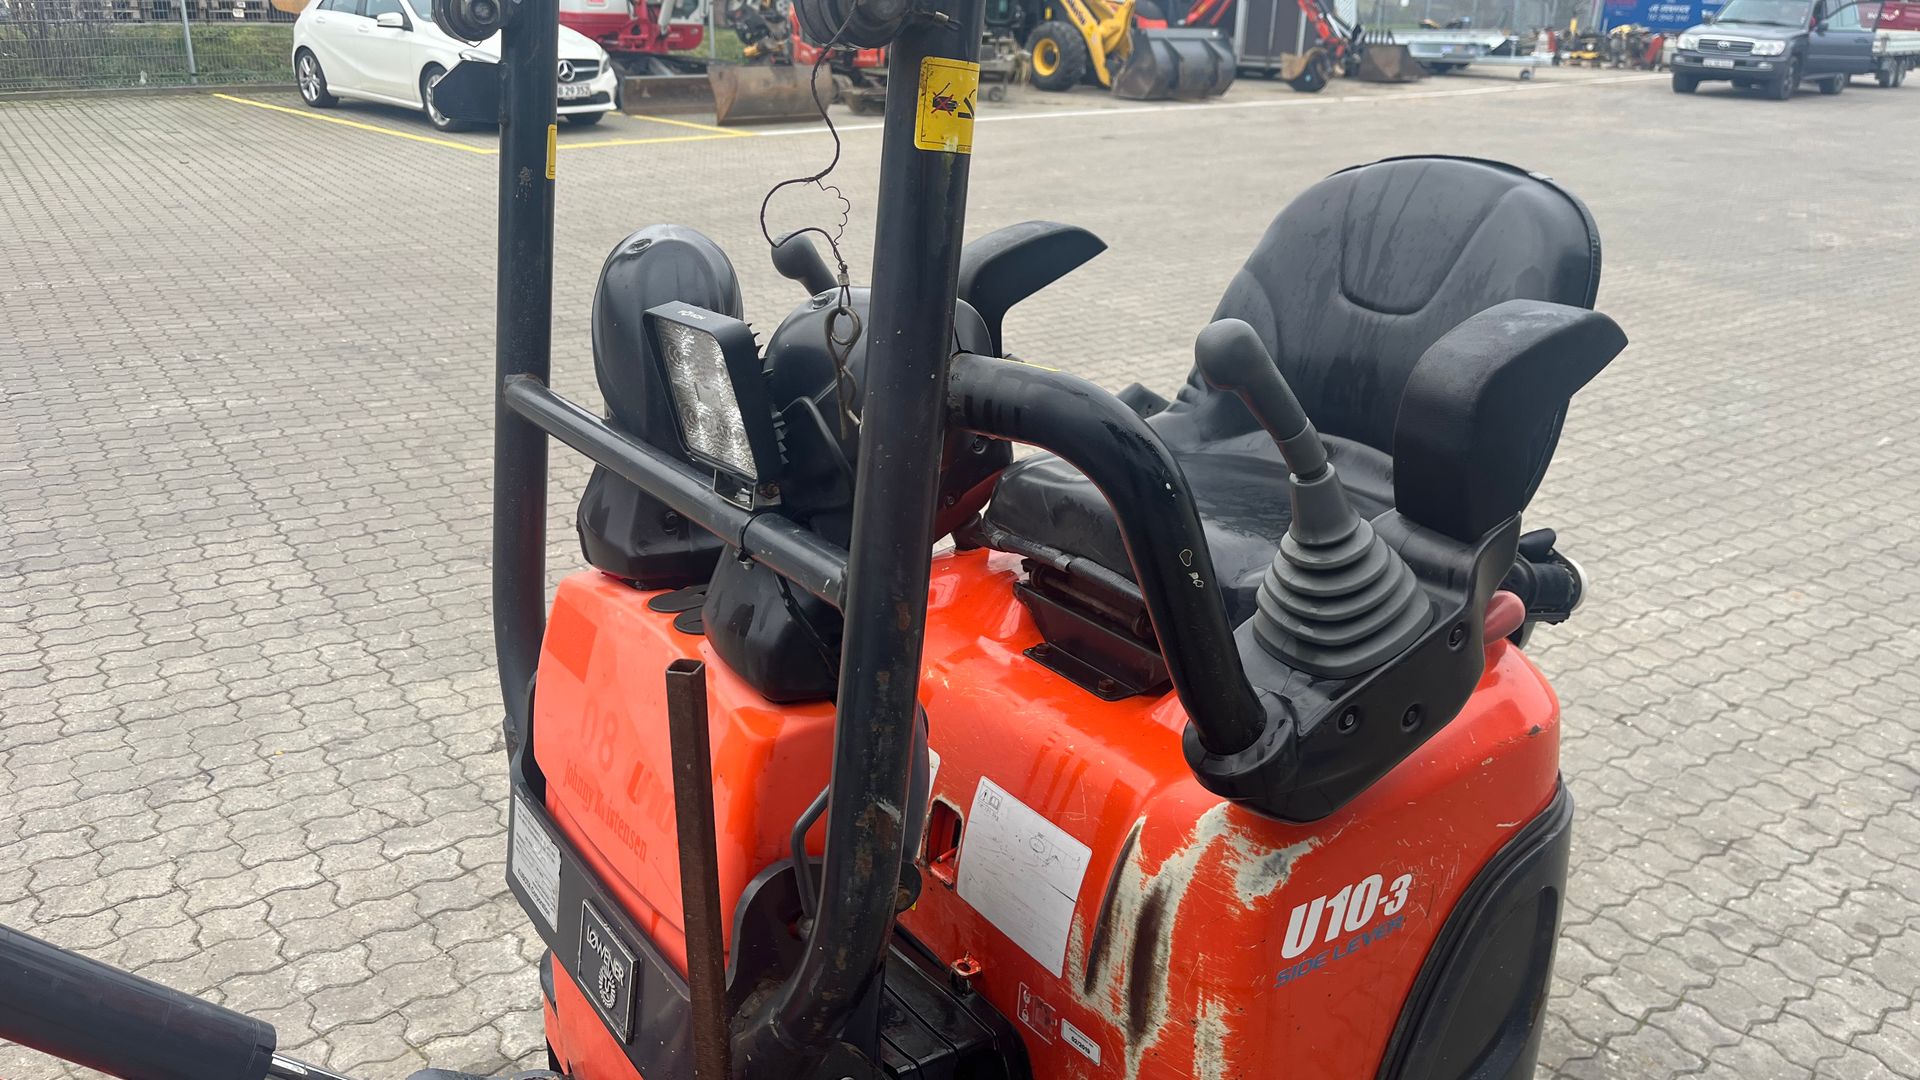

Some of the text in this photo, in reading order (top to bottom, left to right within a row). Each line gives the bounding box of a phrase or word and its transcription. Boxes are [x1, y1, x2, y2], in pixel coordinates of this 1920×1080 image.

[563, 760, 592, 812] Johnny
[1281, 873, 1413, 959] U10-3
[587, 925, 624, 987] LØWENER
[1273, 915, 1406, 988] SIDE LEVER
